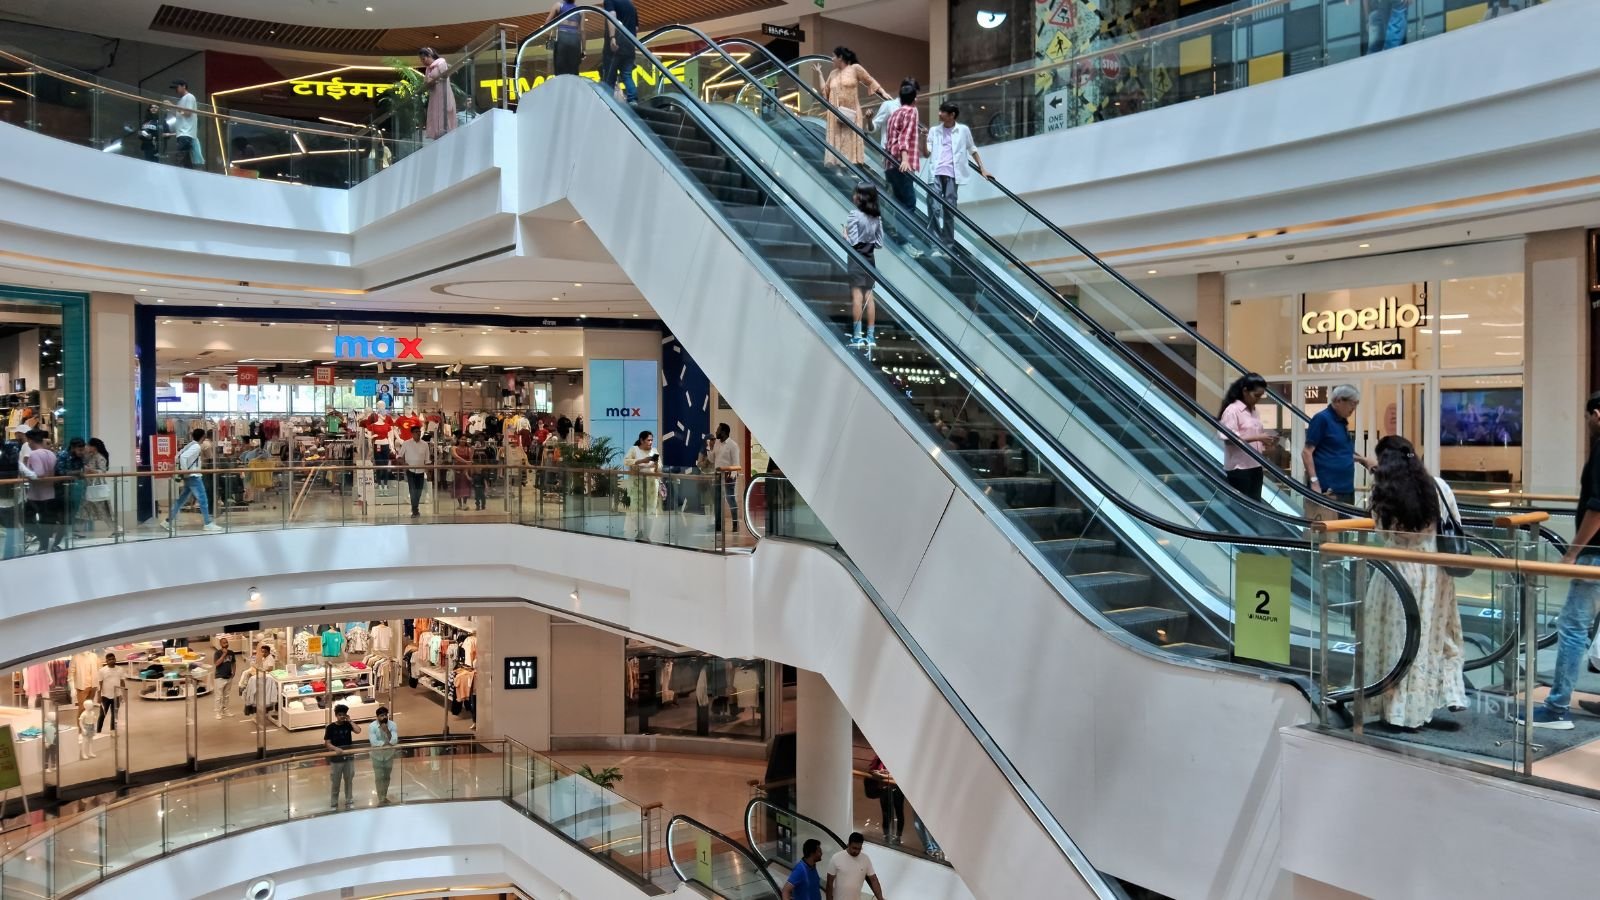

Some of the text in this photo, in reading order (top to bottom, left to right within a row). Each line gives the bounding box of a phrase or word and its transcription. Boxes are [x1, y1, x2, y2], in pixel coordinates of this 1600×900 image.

[1047, 122, 1065, 132] WAY
[1048, 113, 1064, 123] ONE
[1301, 296, 1421, 340] capello
[335, 335, 424, 359] max
[1307, 346, 1351, 361] Luxury
[1362, 341, 1402, 356] Salon
[606, 407, 641, 417] max
[1255, 589, 1270, 615] 2
[1255, 614, 1278, 623] NAGPUR
[509, 667, 532, 685] GAP
